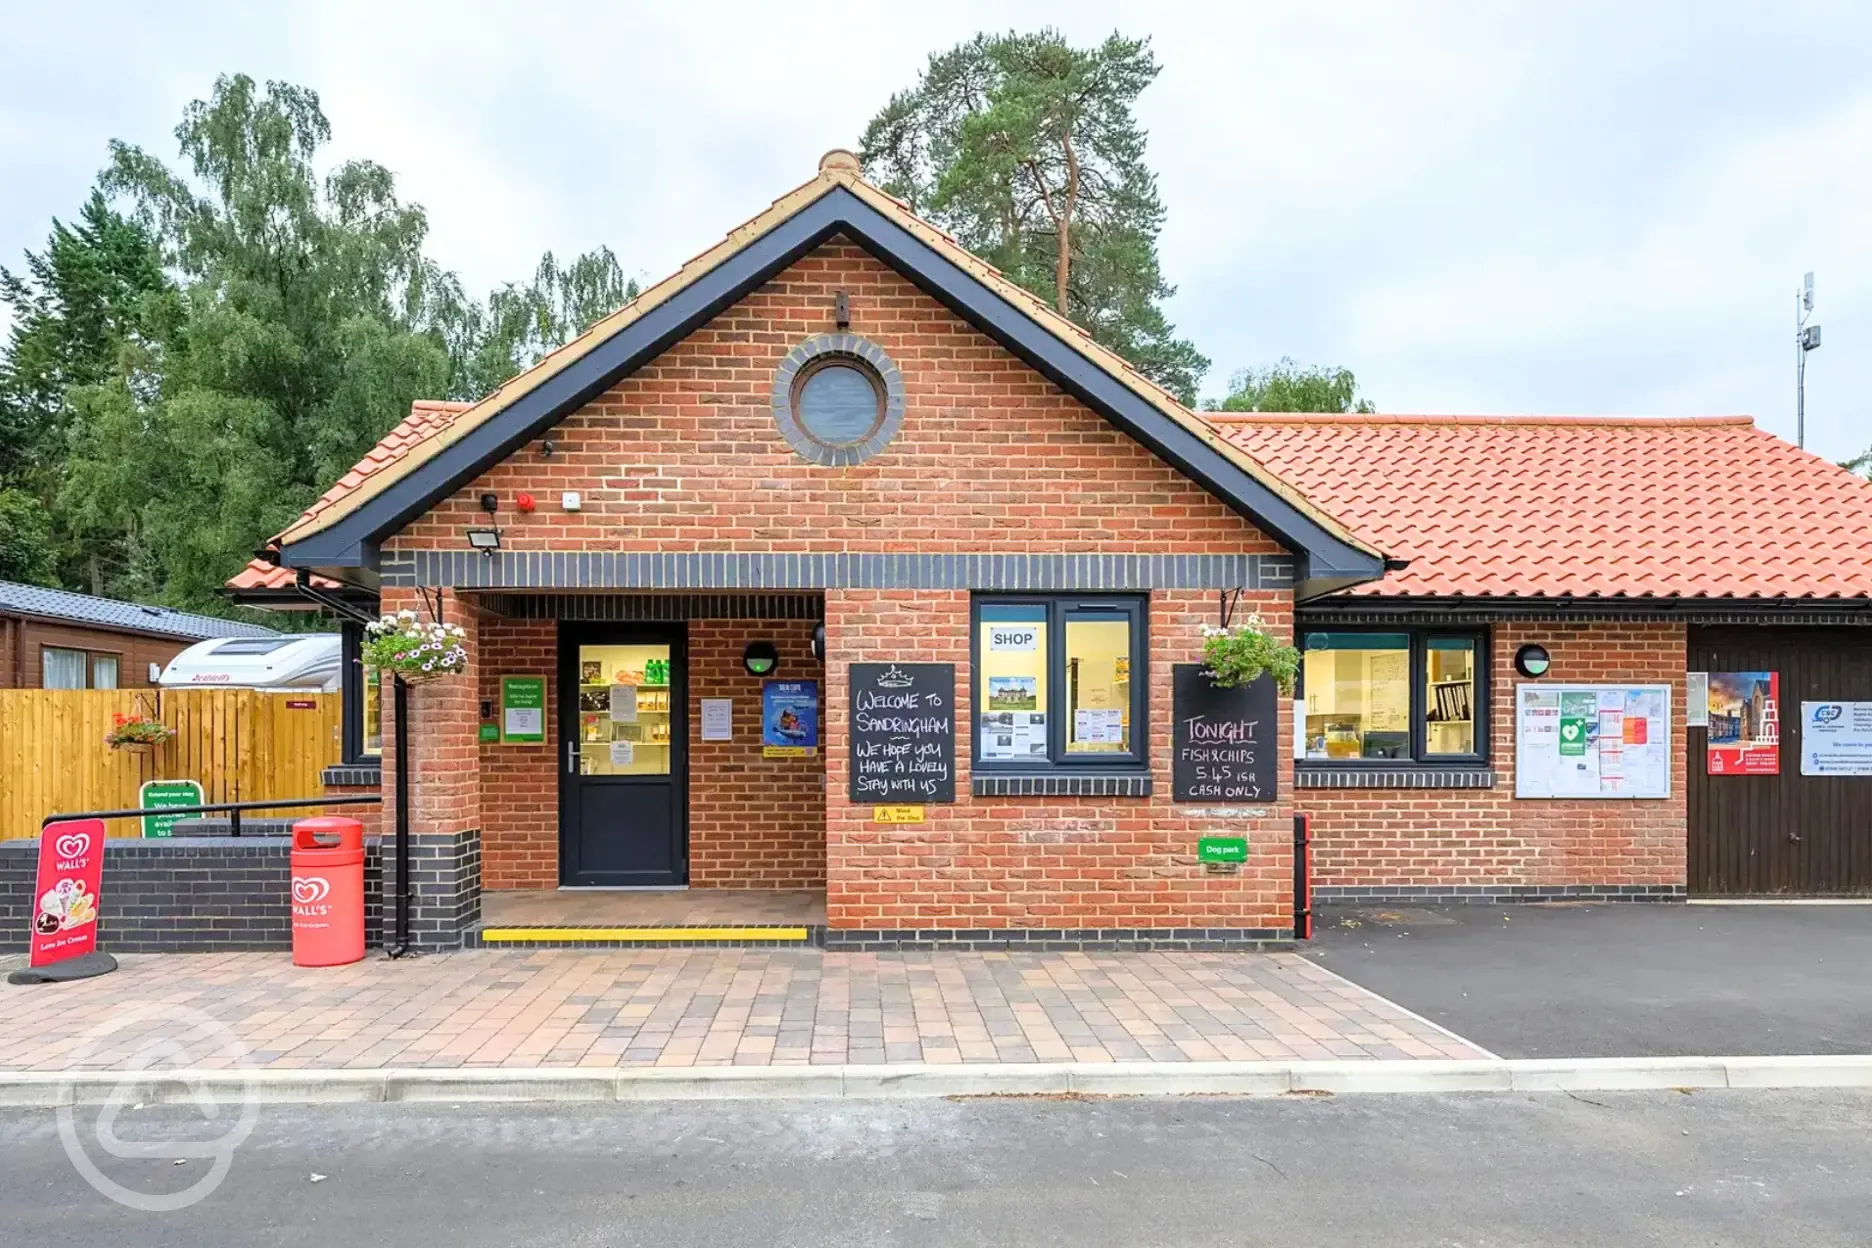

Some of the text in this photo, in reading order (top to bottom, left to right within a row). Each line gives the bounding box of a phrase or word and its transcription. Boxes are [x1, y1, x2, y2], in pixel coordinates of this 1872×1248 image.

[994, 633, 1033, 645] SHOP
[856, 690, 943, 711] WELCOME TO
[855, 712, 950, 738] SANDRINGHAM
[1183, 715, 1259, 744] TONIGHT
[856, 740, 881, 757] WE
[883, 743, 912, 761] HOPE
[859, 759, 947, 781] HAVE A LOVELY
[1236, 772, 1256, 782] ISH
[857, 775, 938, 796] STAY WITH US
[1189, 784, 1261, 798] CASH ONLY
[1206, 845, 1240, 854] Dog park
[56, 859, 87, 871] WALL'S
